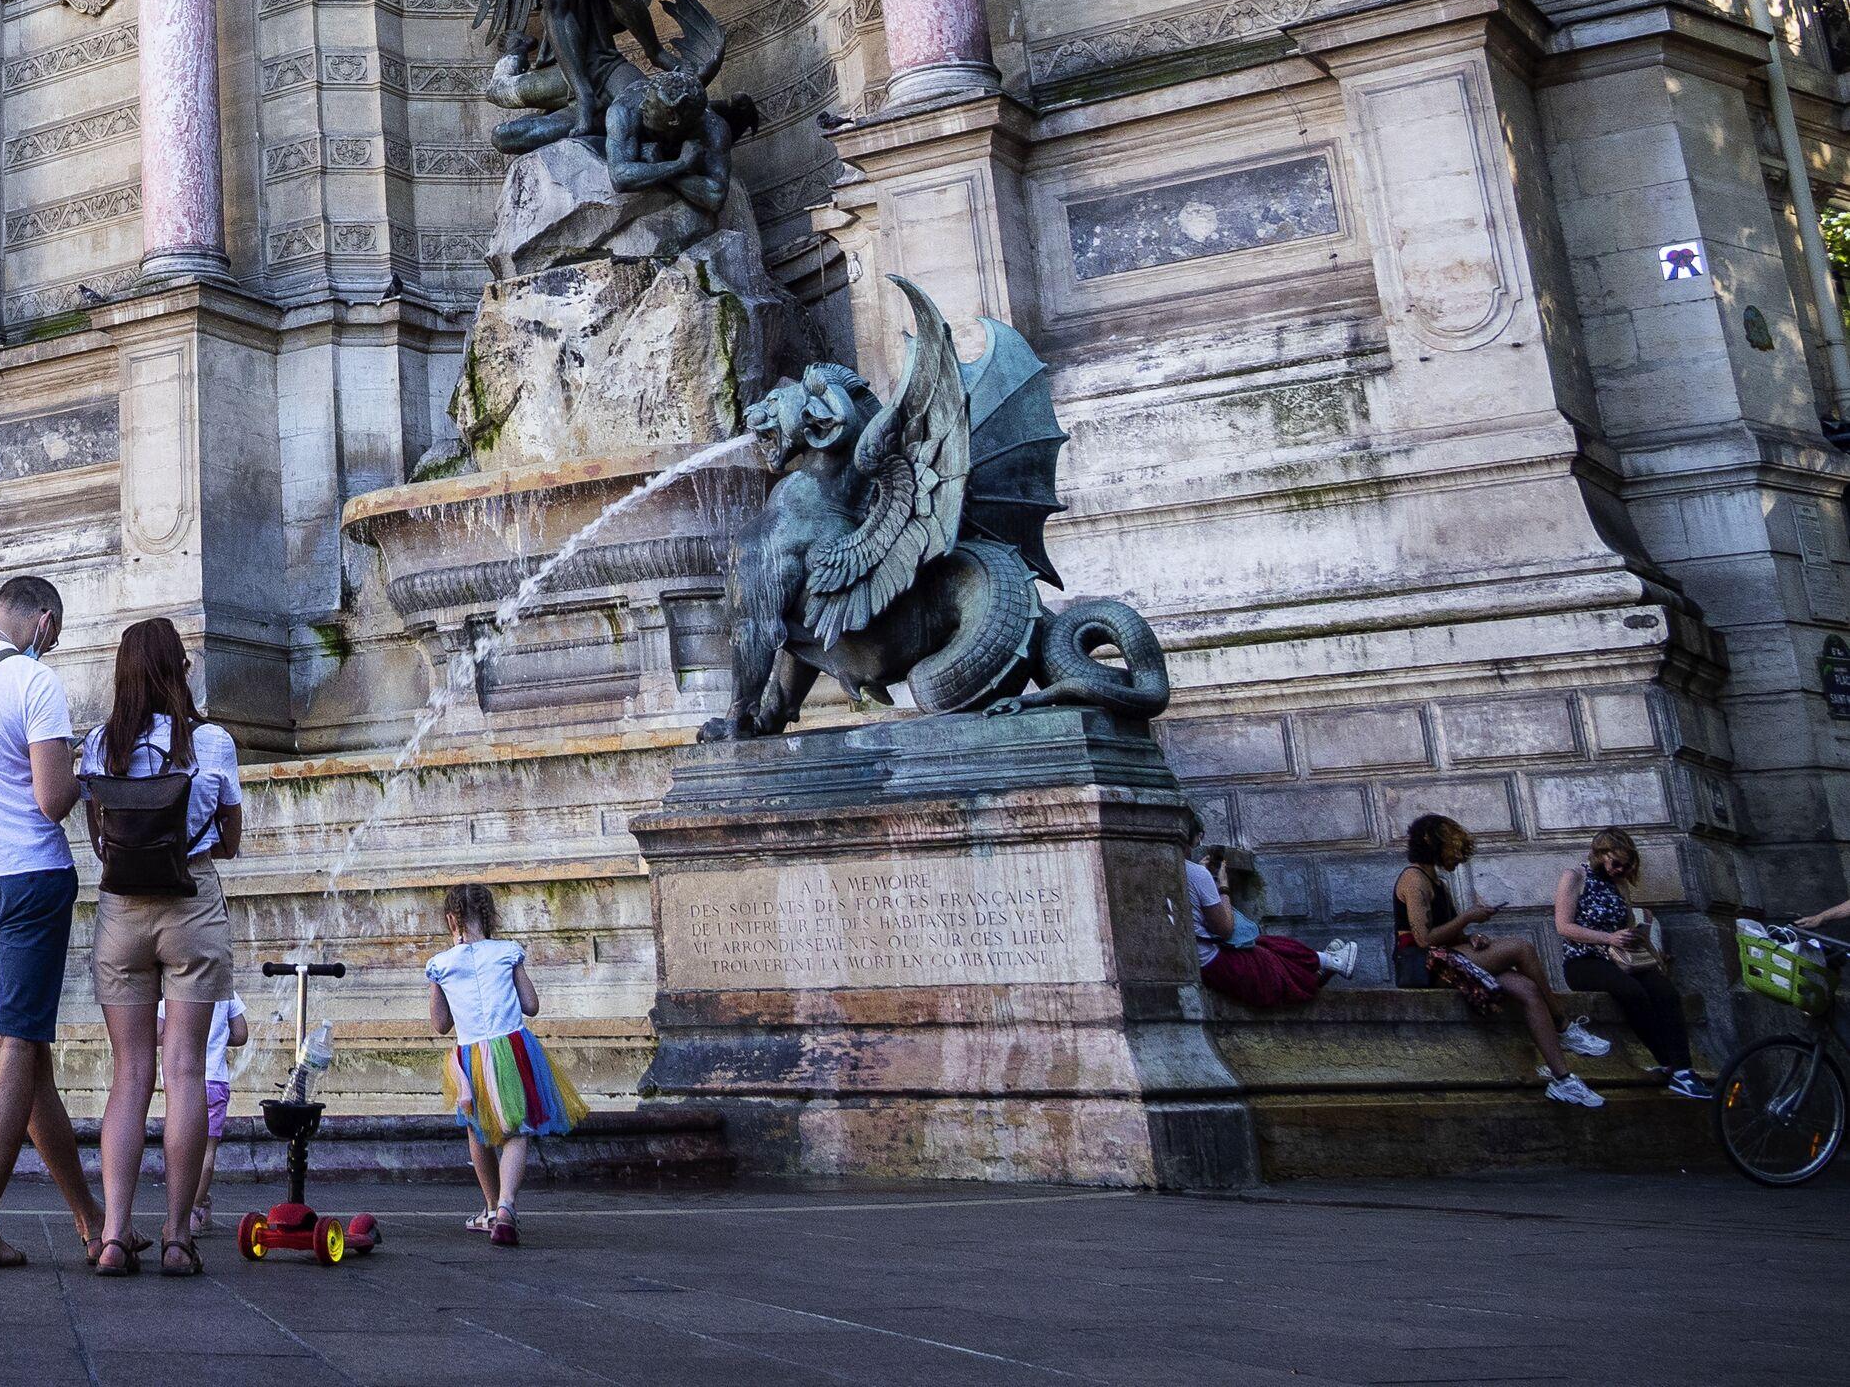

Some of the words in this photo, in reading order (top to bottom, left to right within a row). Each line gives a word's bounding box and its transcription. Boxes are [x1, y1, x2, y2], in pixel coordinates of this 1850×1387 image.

[801, 880, 811, 894] A
[819, 879, 839, 893] LA
[847, 874, 931, 892] MEMOIRE
[690, 904, 720, 918] DES
[729, 901, 805, 915] SOLDATS
[814, 898, 846, 913] DES
[856, 894, 929, 911] FORCES
[940, 887, 1061, 908] FRANÇAISES
[691, 923, 710, 937] DE
[815, 918, 834, 932] ET
[841, 916, 871, 932] DES
[879, 912, 967, 930] HABITANTS
[975, 911, 1008, 926] DES
[1042, 908, 1063, 924] ET
[721, 936, 878, 954] ARRONDISSEMENTS
[888, 935, 919, 950] QUI
[928, 932, 963, 948] SUR
[970, 931, 1003, 946] CES
[1012, 929, 1065, 945] LIEUX
[712, 957, 811, 973] TROUVERENT
[821, 957, 840, 971] LA
[847, 955, 894, 971] MORT
[902, 954, 923, 968] EN
